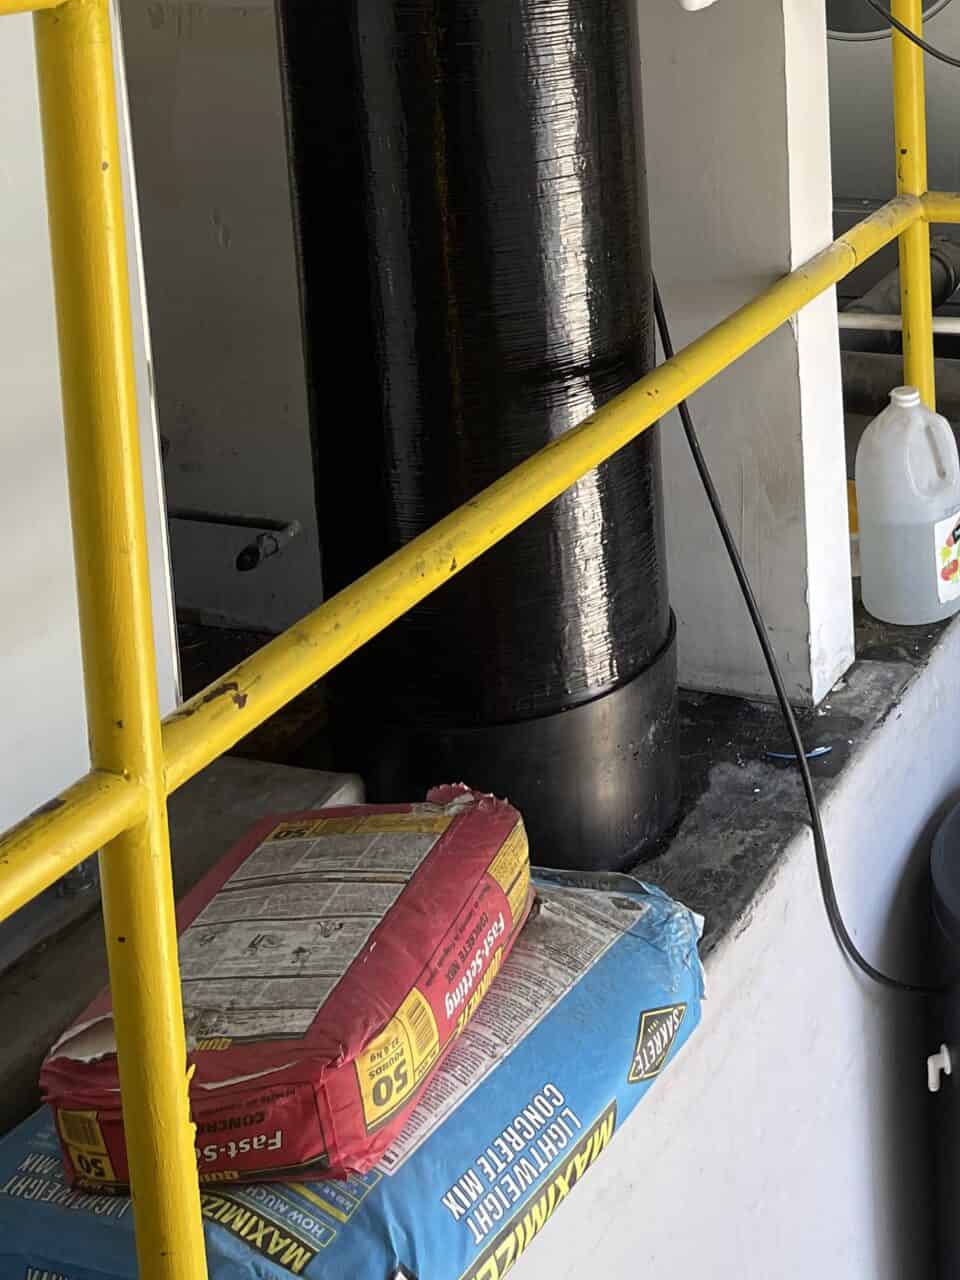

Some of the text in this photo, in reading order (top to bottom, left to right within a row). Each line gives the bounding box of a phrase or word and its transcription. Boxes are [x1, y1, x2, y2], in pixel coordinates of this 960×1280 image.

[444, 911, 505, 1019] Fast-Setting
[634, 1008, 681, 1078] SAKRETE
[372, 1058, 408, 1107] 50
[476, 1083, 566, 1182] CONCRETE
[77, 1151, 106, 1178] 50
[466, 1107, 582, 1245] LIGHTWEIGHT
[245, 1185, 290, 1213] MUCH
[441, 1169, 485, 1221] MIX
[287, 1210, 326, 1238] HOW
